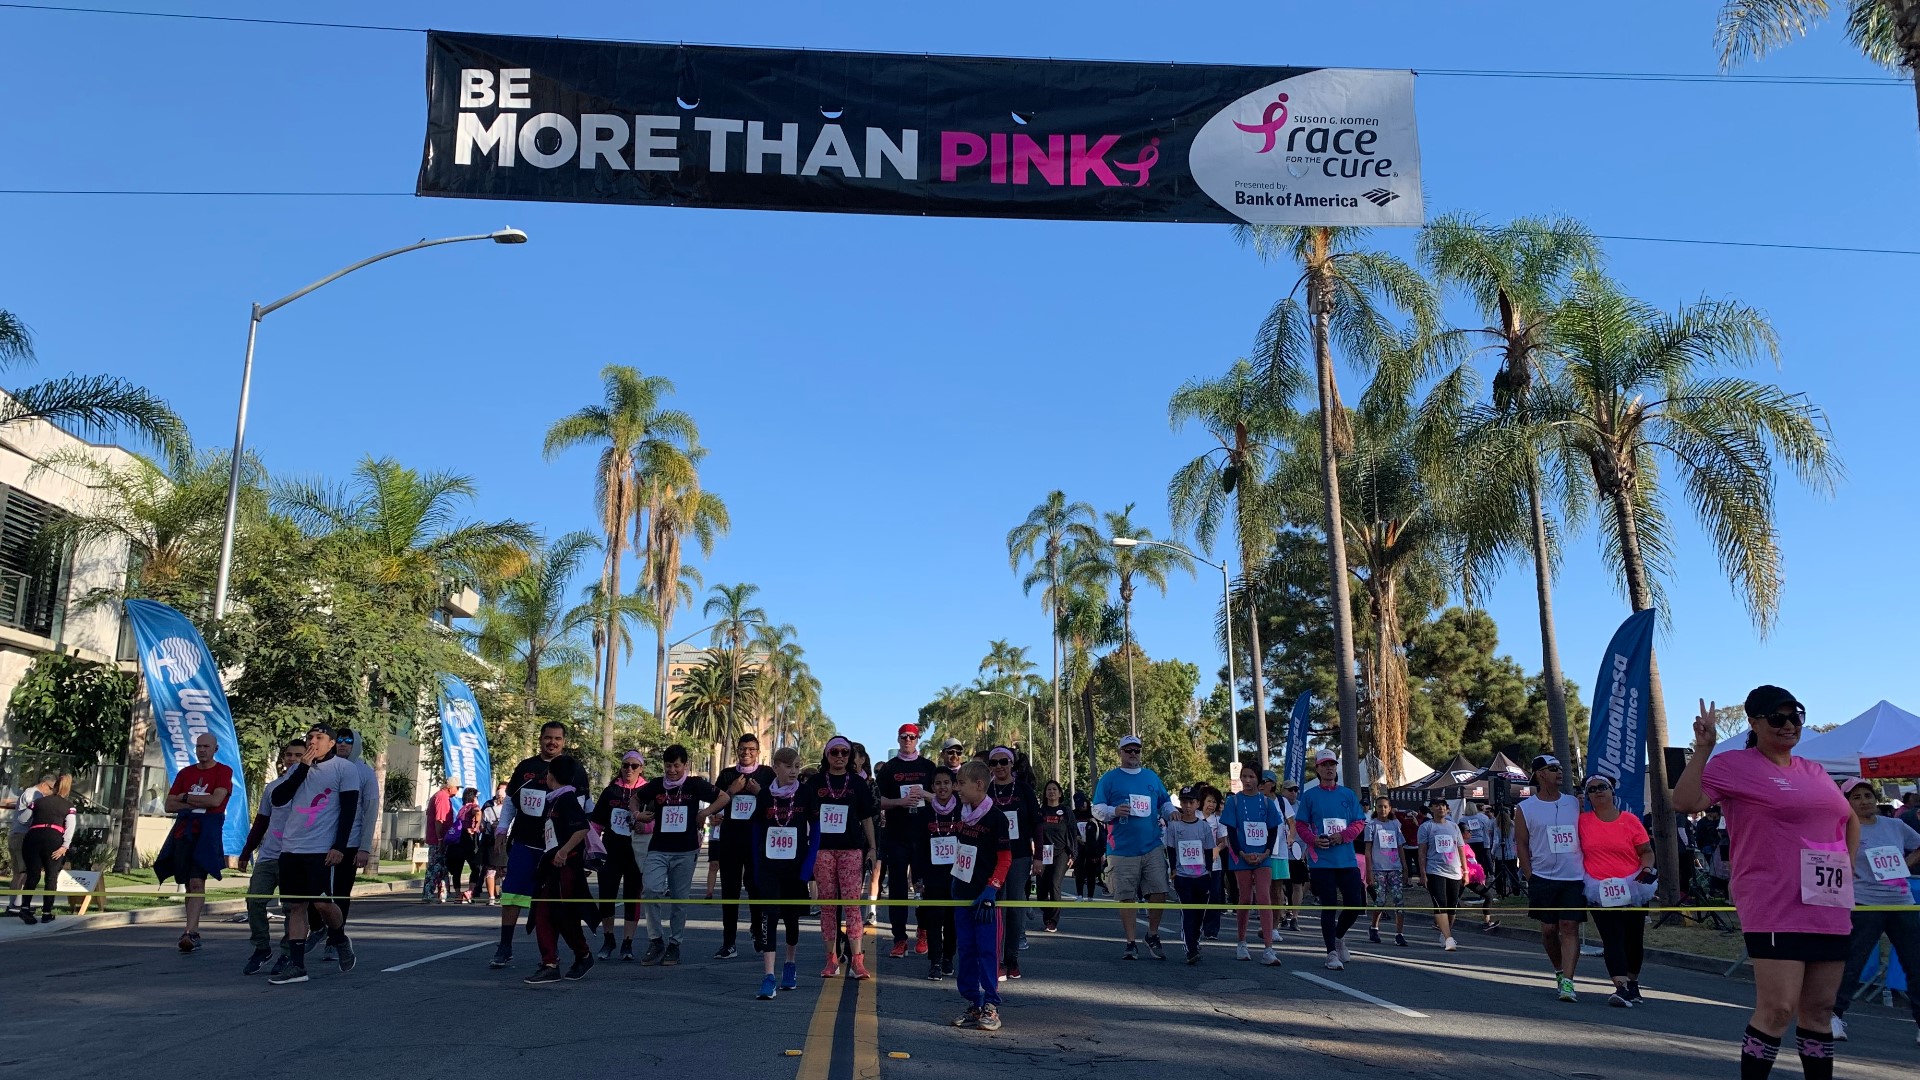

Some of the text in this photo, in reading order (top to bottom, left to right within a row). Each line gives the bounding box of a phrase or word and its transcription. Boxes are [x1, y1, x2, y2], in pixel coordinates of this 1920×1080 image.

[459, 68, 531, 109] BE
[1286, 126, 1378, 156] race
[454, 112, 681, 171] MORE
[695, 116, 918, 180] THAN
[940, 130, 1123, 187] PINK
[1285, 156, 1303, 164] FOR
[1304, 156, 1321, 164] THE
[1234, 180, 1275, 190] Presented
[1235, 190, 1359, 208] Bank of America
[1621, 687, 1639, 773] Insurance
[165, 711, 191, 771] Insuran
[523, 796, 542, 807] 3378
[735, 802, 753, 812] 3097
[1132, 800, 1149, 810] 2699
[613, 815, 629, 826] 337
[665, 812, 684, 824] 3376
[823, 812, 843, 824] 3491
[1247, 828, 1264, 838] 2698
[1552, 832, 1574, 844] 3055
[770, 836, 793, 849] 3489
[935, 844, 955, 856] 3250
[1182, 847, 1200, 857] 2696
[1873, 854, 1900, 869] 6079
[1815, 866, 1843, 889] 578
[1603, 885, 1626, 897] 3054
